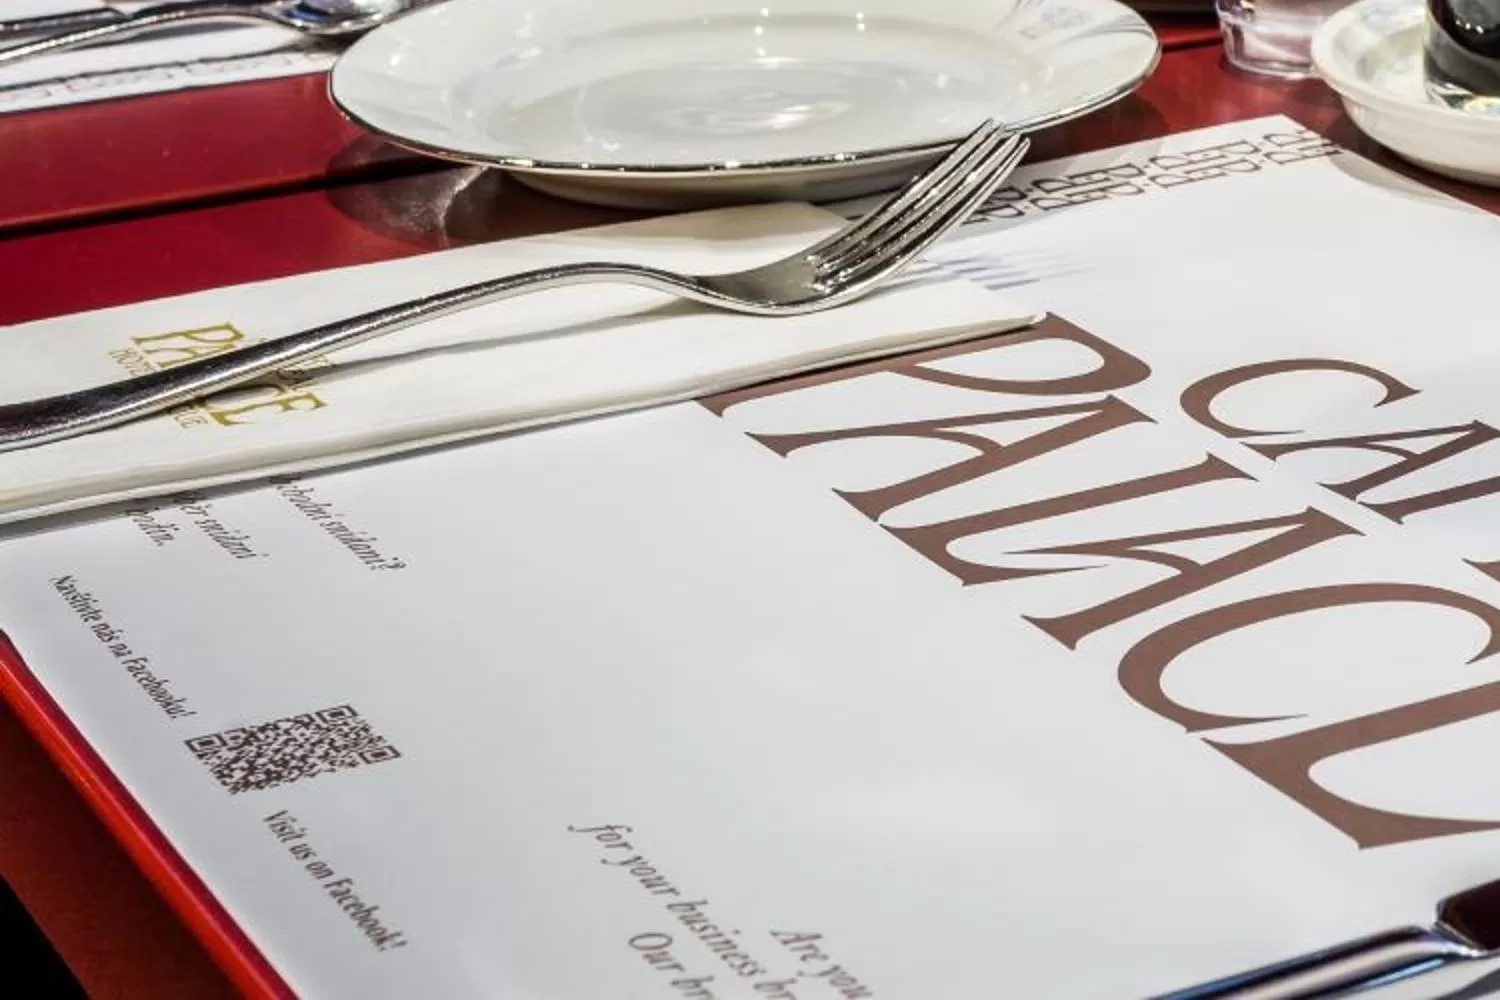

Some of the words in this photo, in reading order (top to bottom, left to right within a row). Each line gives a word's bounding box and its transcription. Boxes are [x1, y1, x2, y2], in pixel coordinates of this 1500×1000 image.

[108, 643, 133, 659] na
[121, 657, 198, 719] Facebooku!
[262, 809, 307, 843] Visit
[288, 843, 317, 861] us
[304, 861, 335, 880] on
[323, 877, 408, 952] Facebook!
[567, 823, 633, 851] for
[600, 855, 680, 896] your
[666, 899, 767, 977] business
[628, 932, 685, 972] Our
[769, 929, 829, 963] Are
